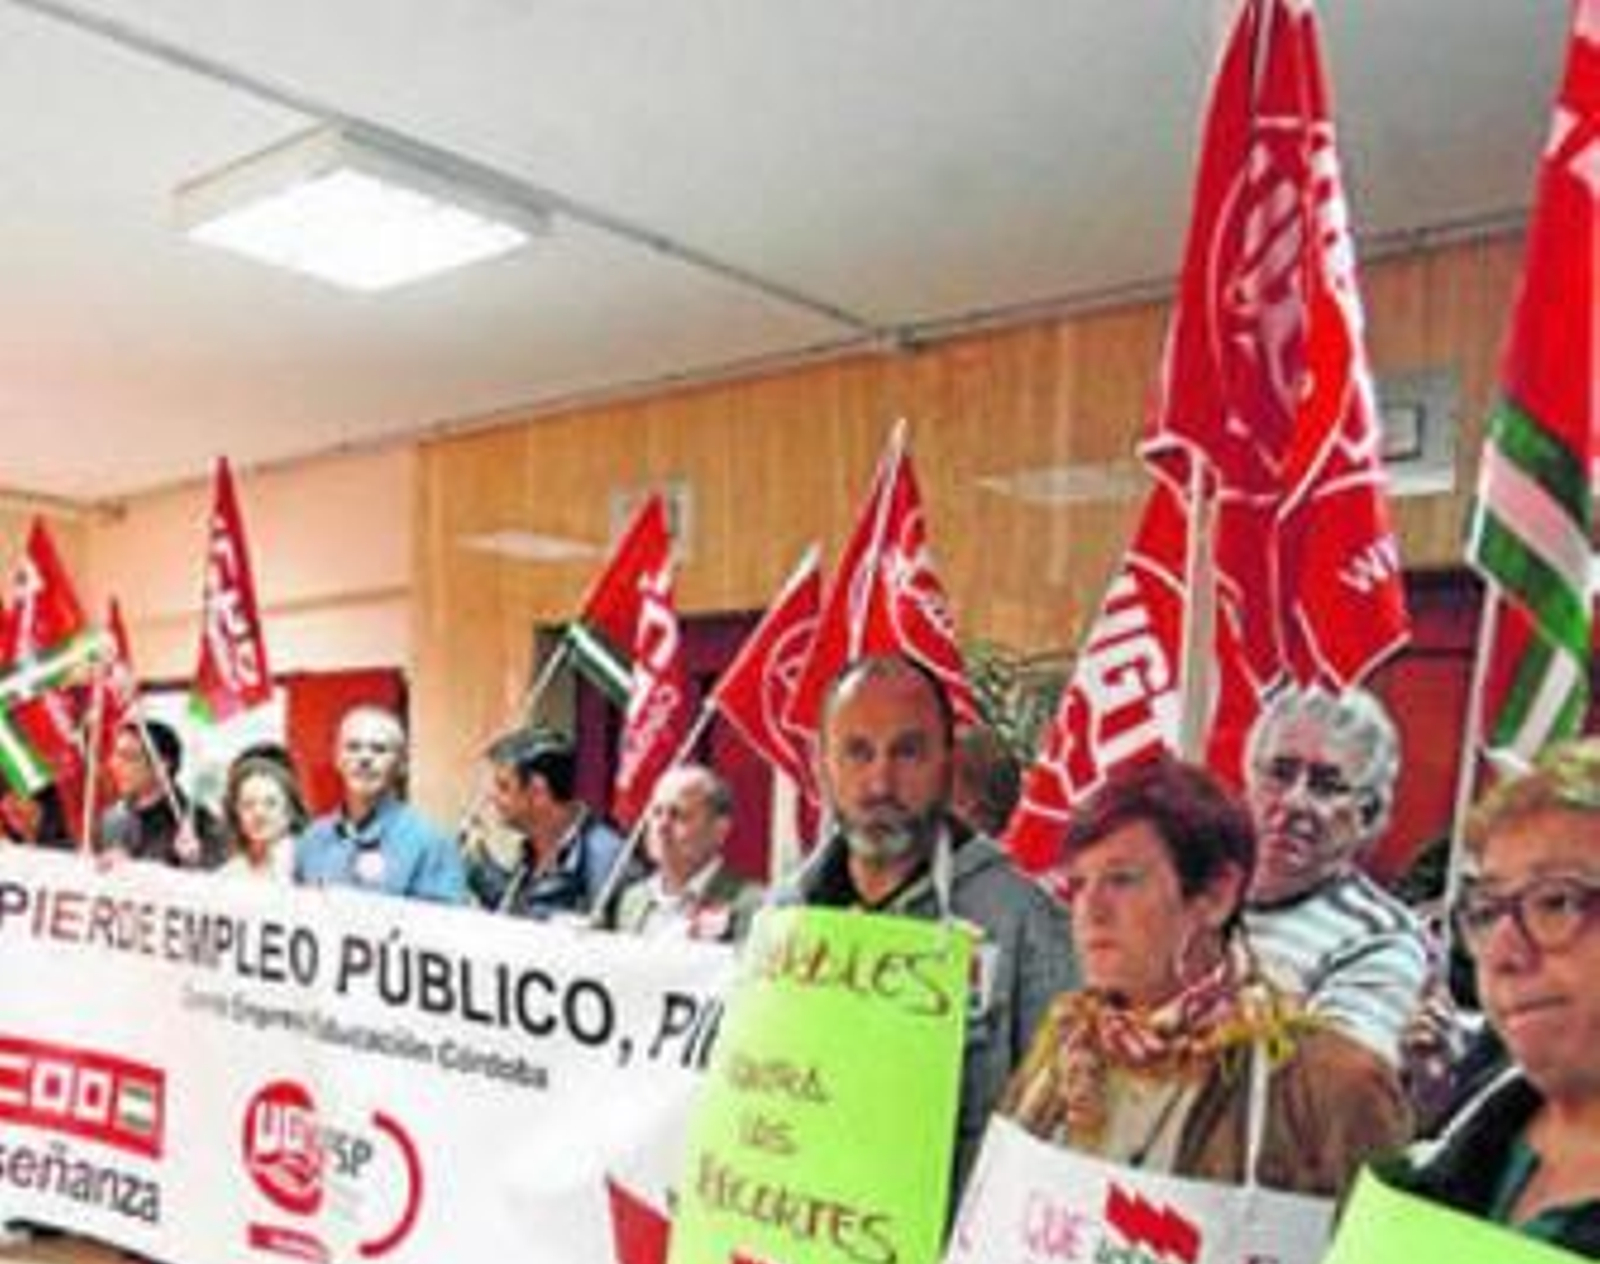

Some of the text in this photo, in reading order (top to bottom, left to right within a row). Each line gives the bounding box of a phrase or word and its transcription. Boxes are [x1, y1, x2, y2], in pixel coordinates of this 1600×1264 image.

[0, 882, 156, 956] PIERDE
[164, 904, 320, 987] EMPLEO
[335, 928, 635, 1065] PÚBLICO,
